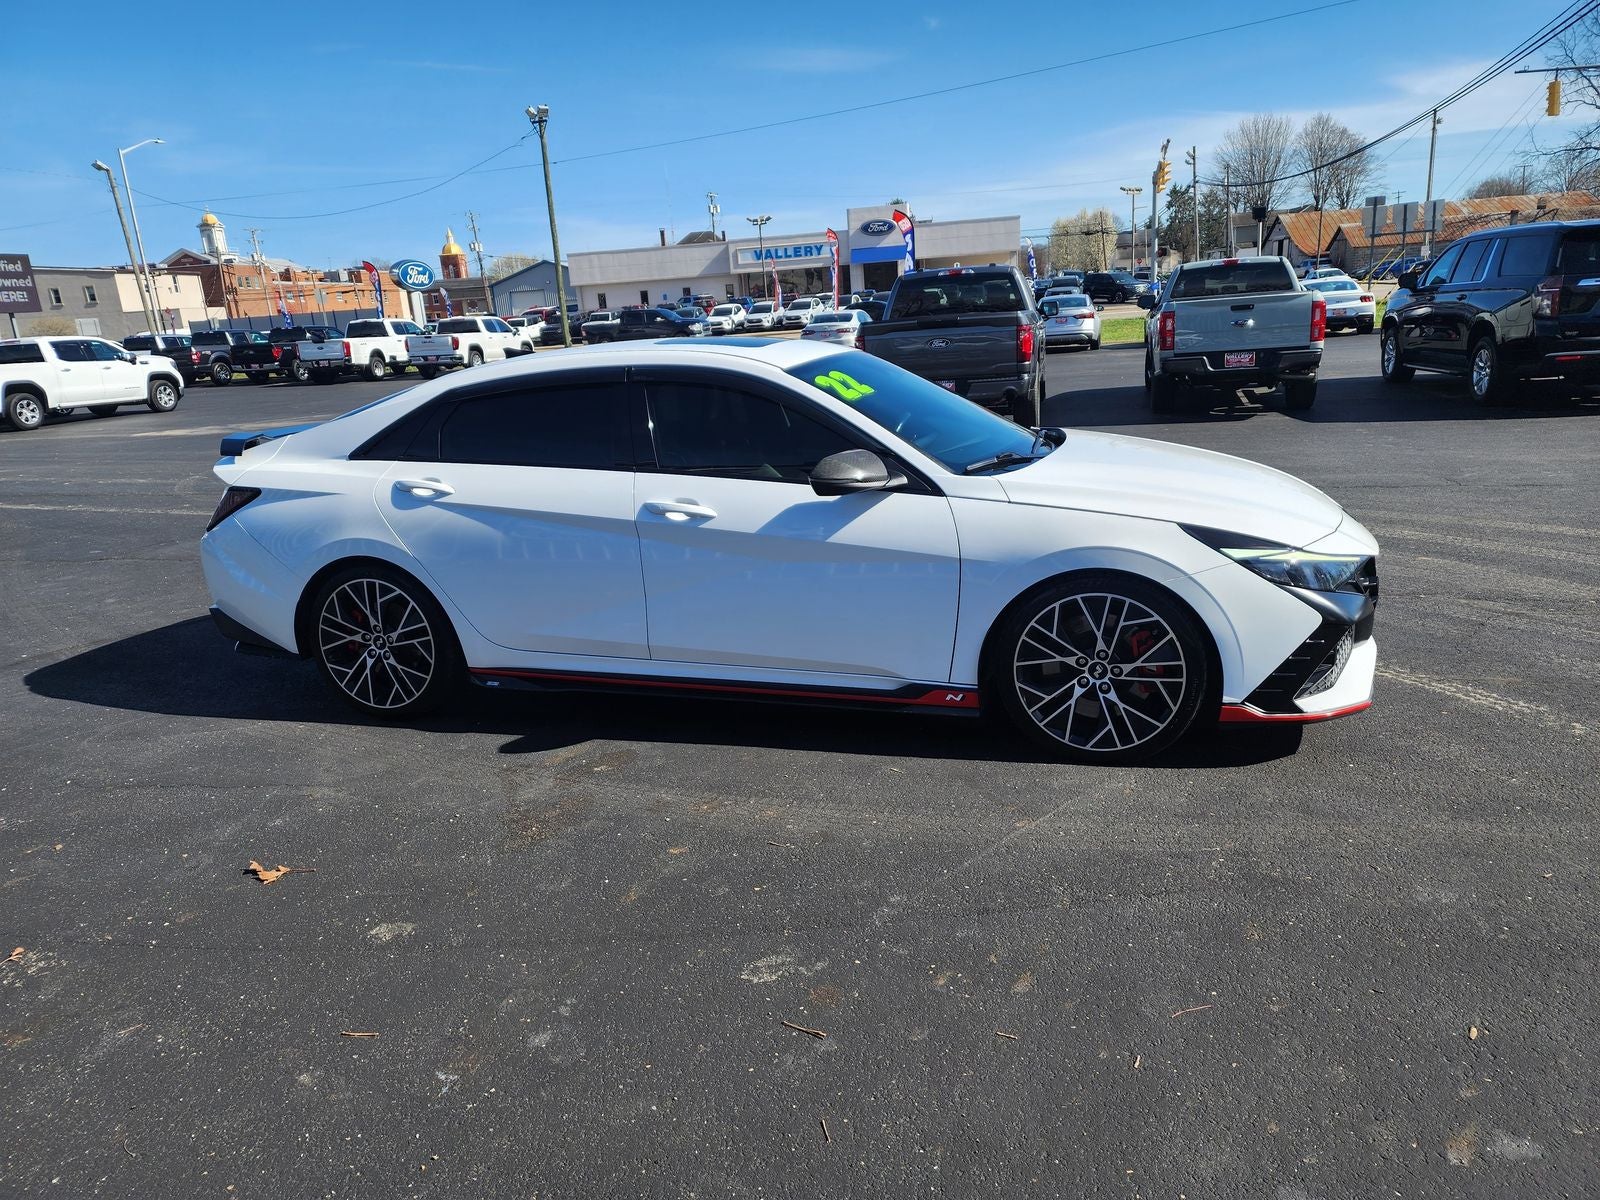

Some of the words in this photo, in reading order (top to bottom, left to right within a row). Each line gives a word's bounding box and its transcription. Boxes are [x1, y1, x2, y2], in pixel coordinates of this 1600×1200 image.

[868, 222, 889, 232] Ford
[753, 244, 824, 261] VALLERY
[406, 265, 430, 284] Ford
[0, 290, 29, 302] ERE!
[814, 370, 875, 401] 22
[945, 693, 964, 702] N
